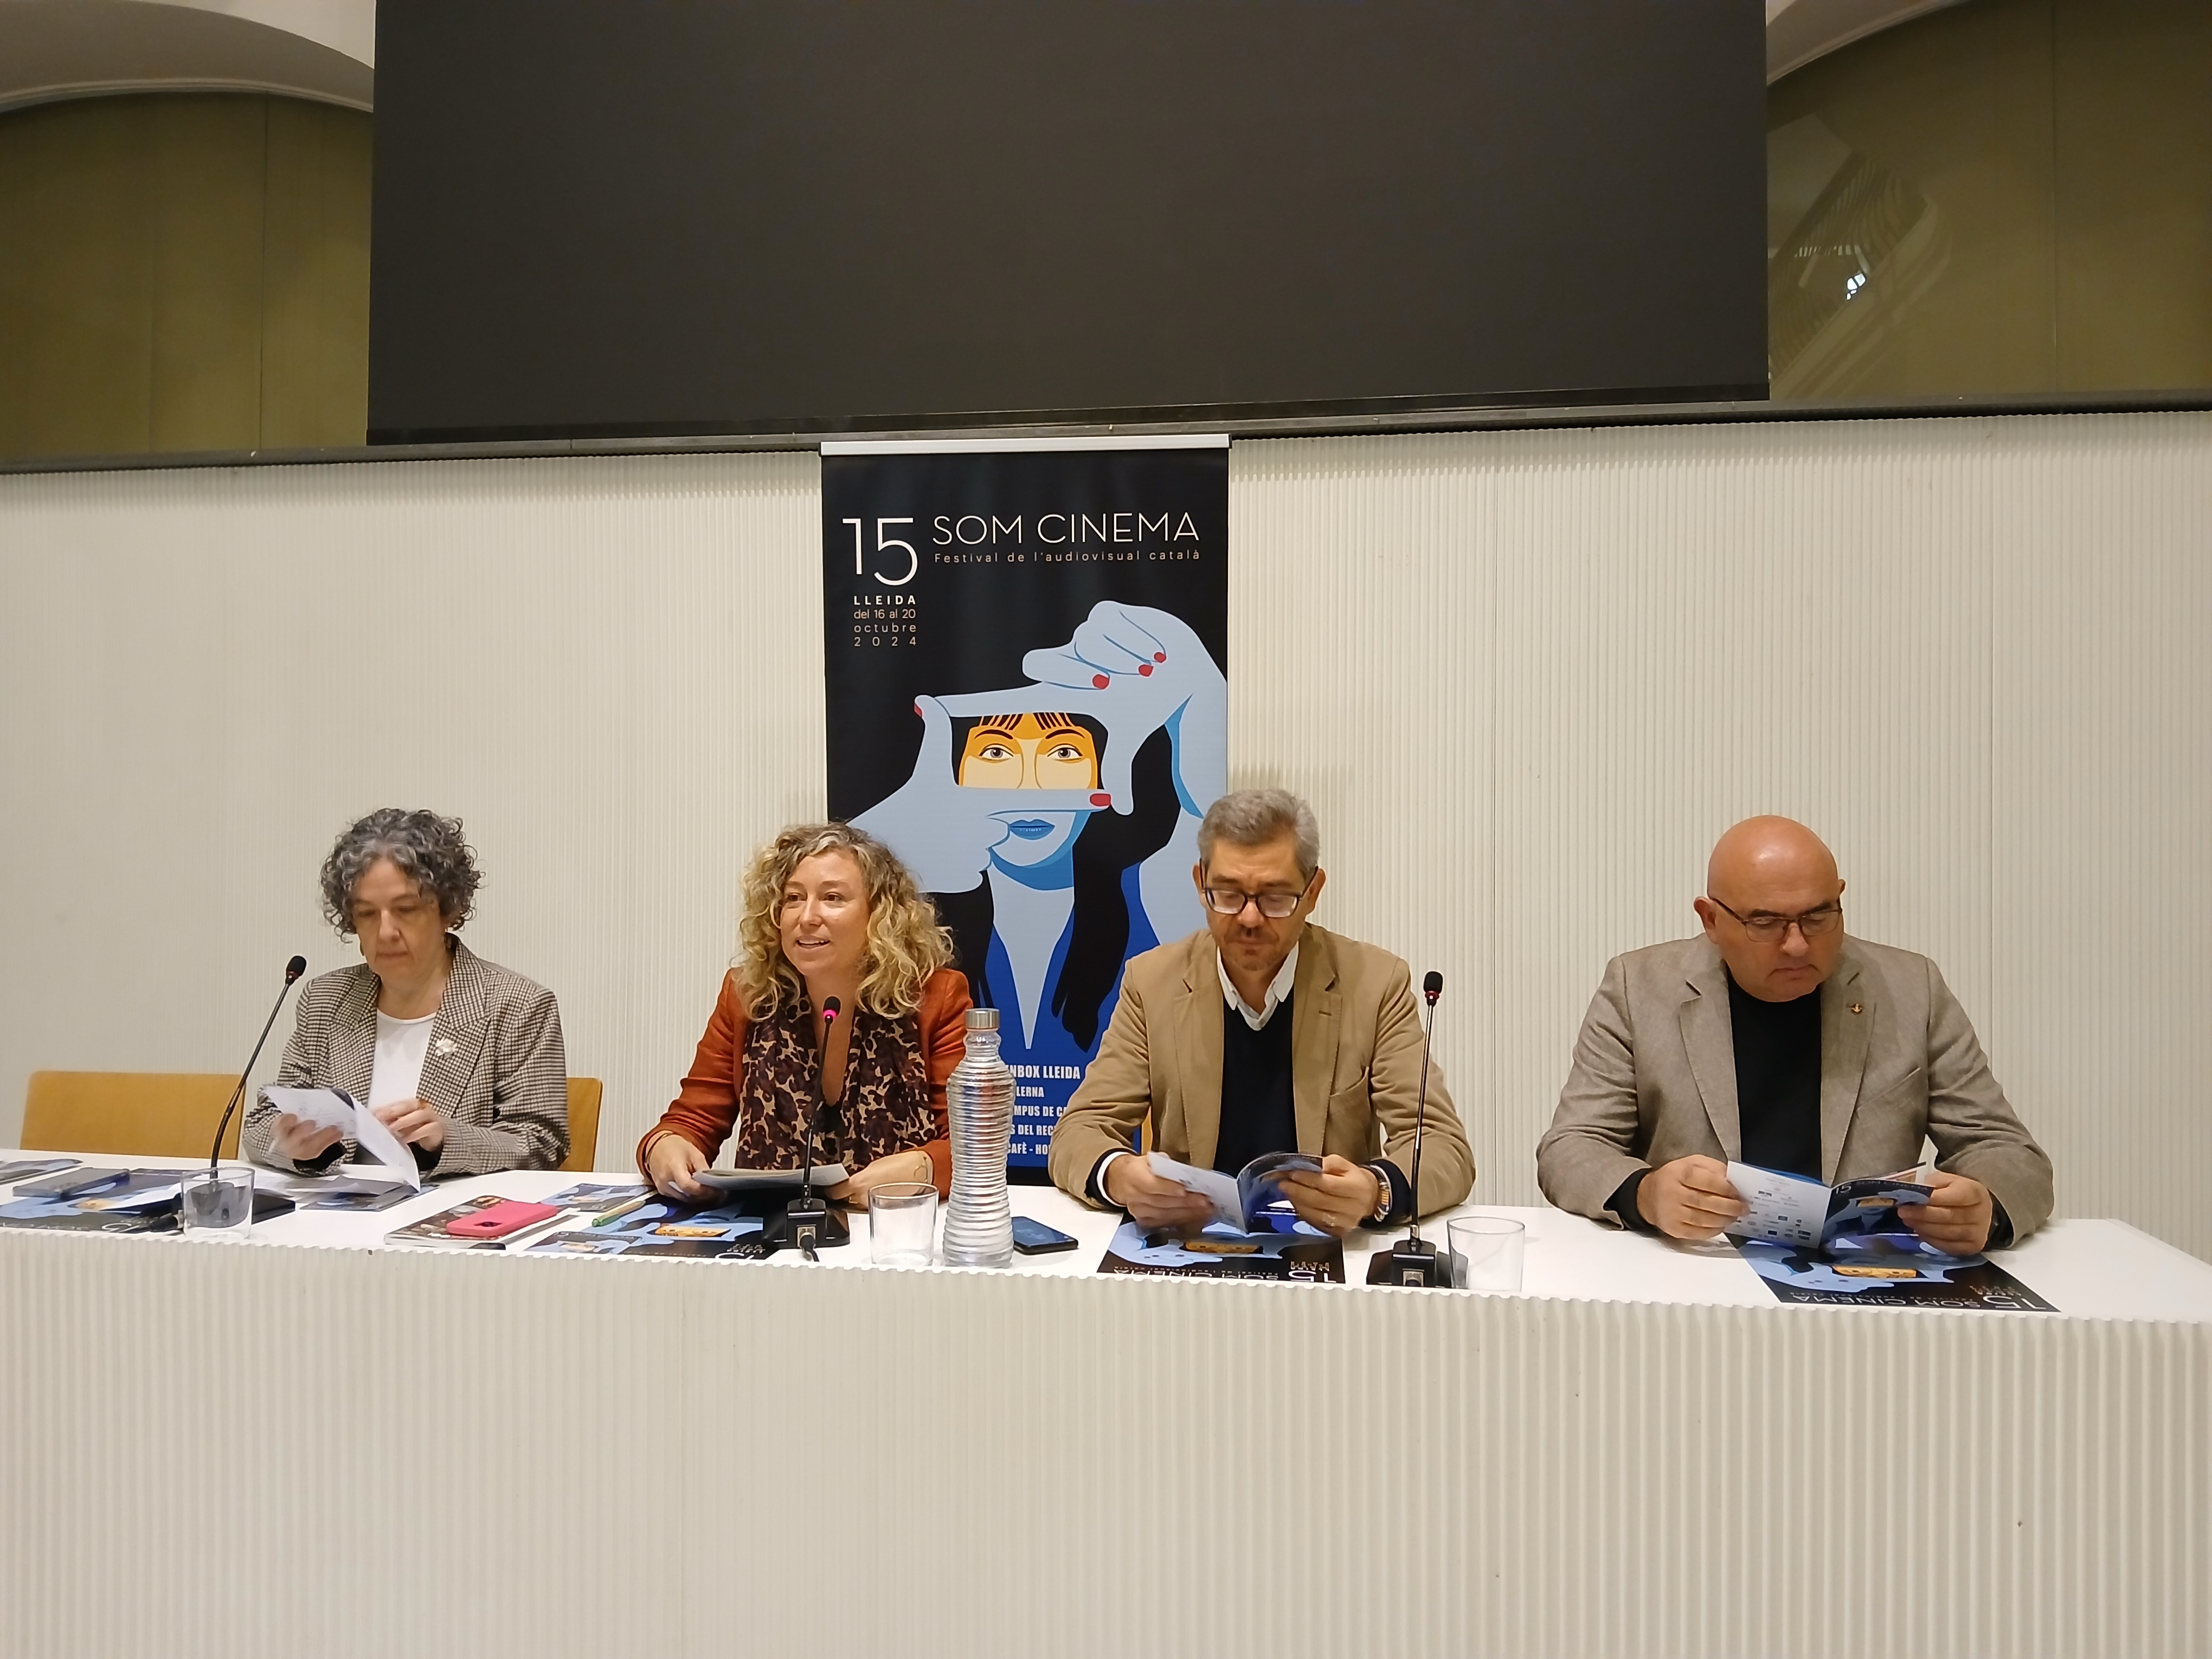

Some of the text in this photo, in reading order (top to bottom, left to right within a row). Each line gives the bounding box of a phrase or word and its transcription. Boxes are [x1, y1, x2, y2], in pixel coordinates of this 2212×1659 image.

[933, 512, 1199, 545] SOM CINEMA
[842, 517, 918, 586] 15
[935, 549, 1199, 563] Festival de l'audiovisual català
[854, 595, 916, 606] LLEIDA
[853, 608, 916, 619] del 16 al 20
[854, 622, 916, 633] octubre
[854, 636, 916, 647] 2024
[1005, 1065, 1081, 1079] NBOX LLEIDA
[1016, 1086, 1044, 1097] LERNA
[1014, 1105, 1040, 1116] MPUS
[1043, 1106, 1054, 1117] DE
[1018, 1124, 1034, 1135] DEL
